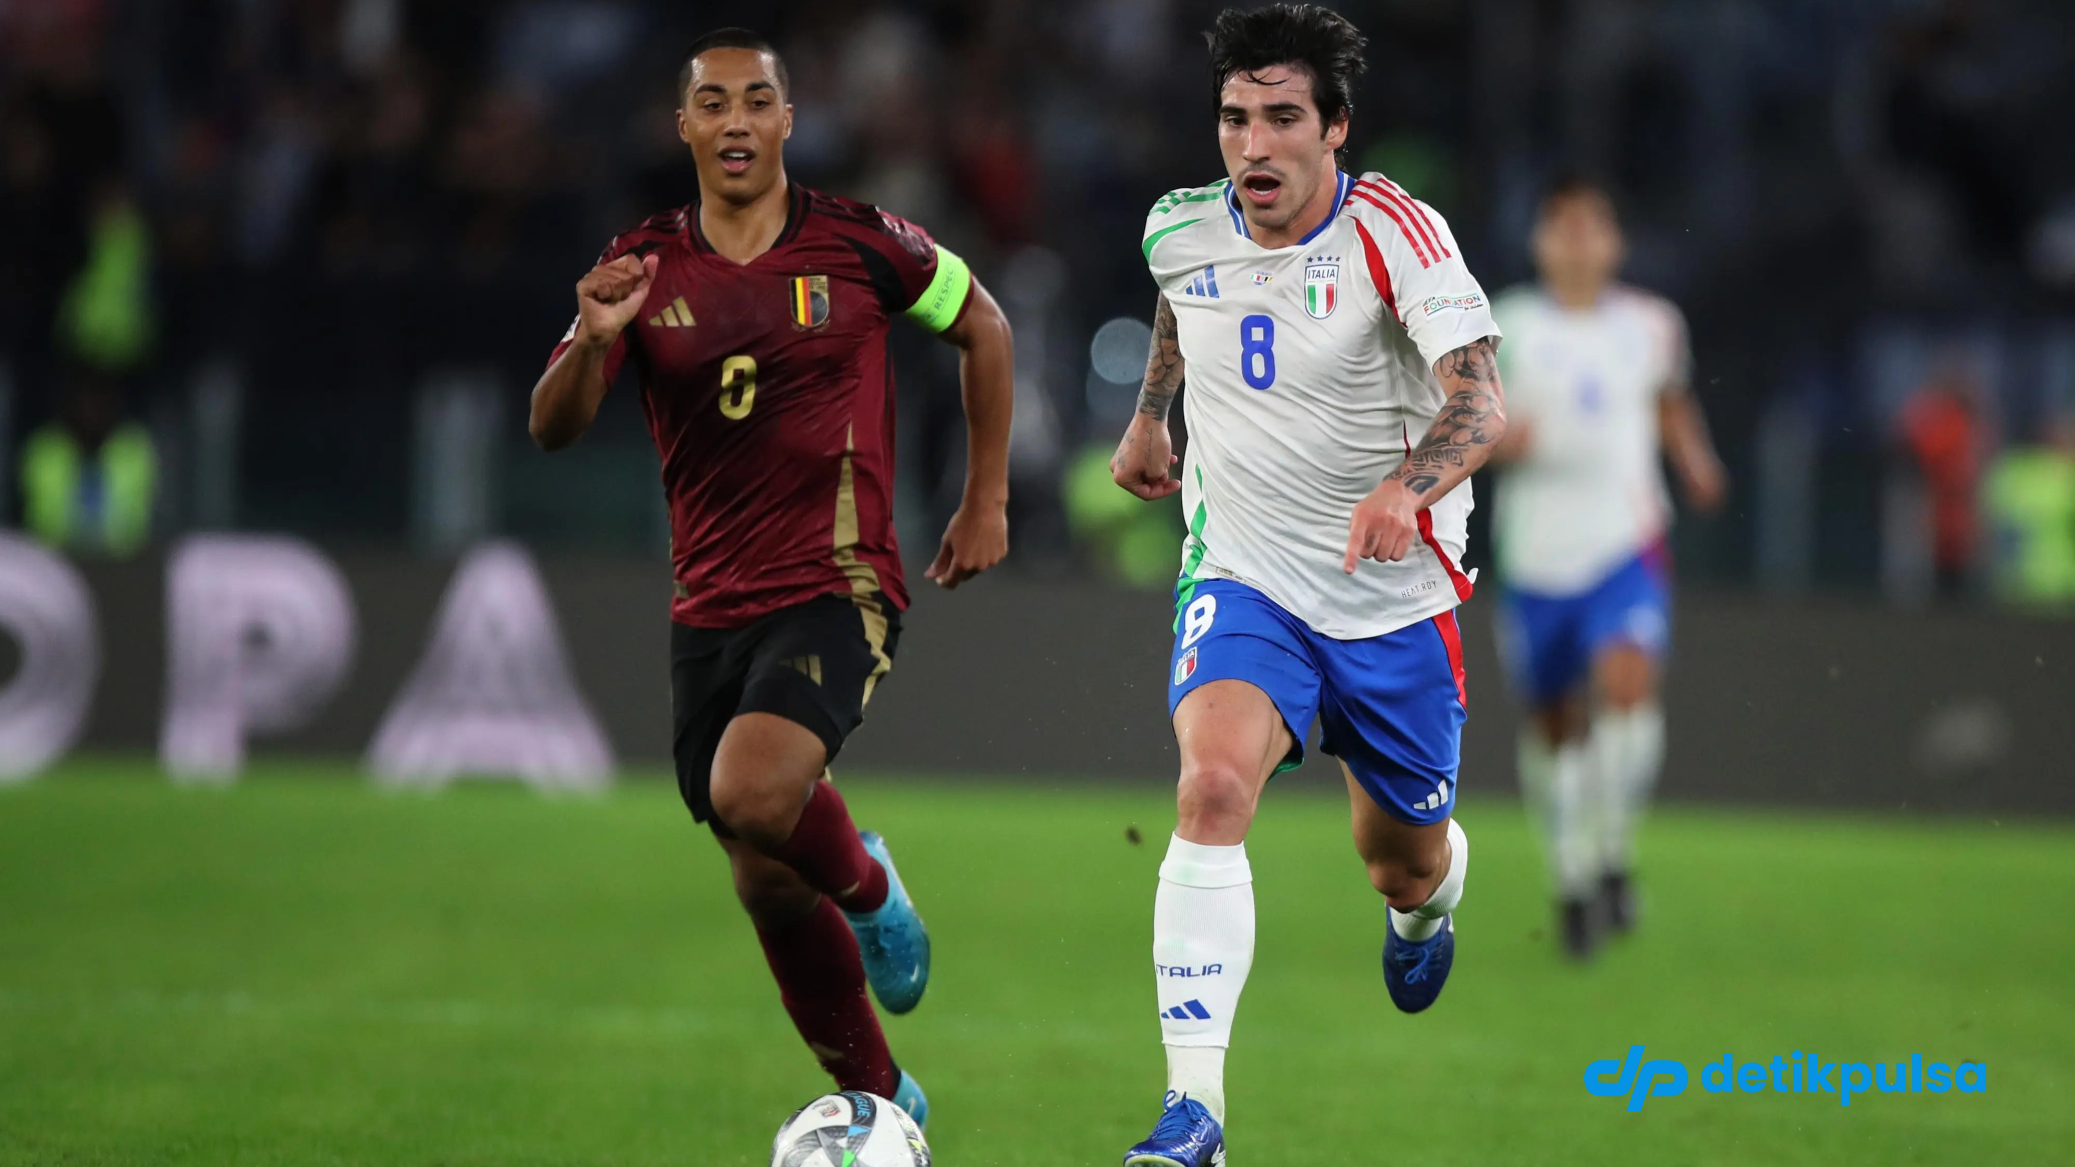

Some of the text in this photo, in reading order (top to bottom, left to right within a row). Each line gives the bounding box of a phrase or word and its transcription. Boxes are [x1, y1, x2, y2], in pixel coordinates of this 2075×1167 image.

[934, 262, 954, 310] RESPEC
[1307, 268, 1336, 280] ITALIA
[1423, 295, 1481, 314] FOUNATION
[1240, 314, 1276, 390] 8
[1181, 593, 1217, 650] 8
[1155, 963, 1223, 978] ITALIA
